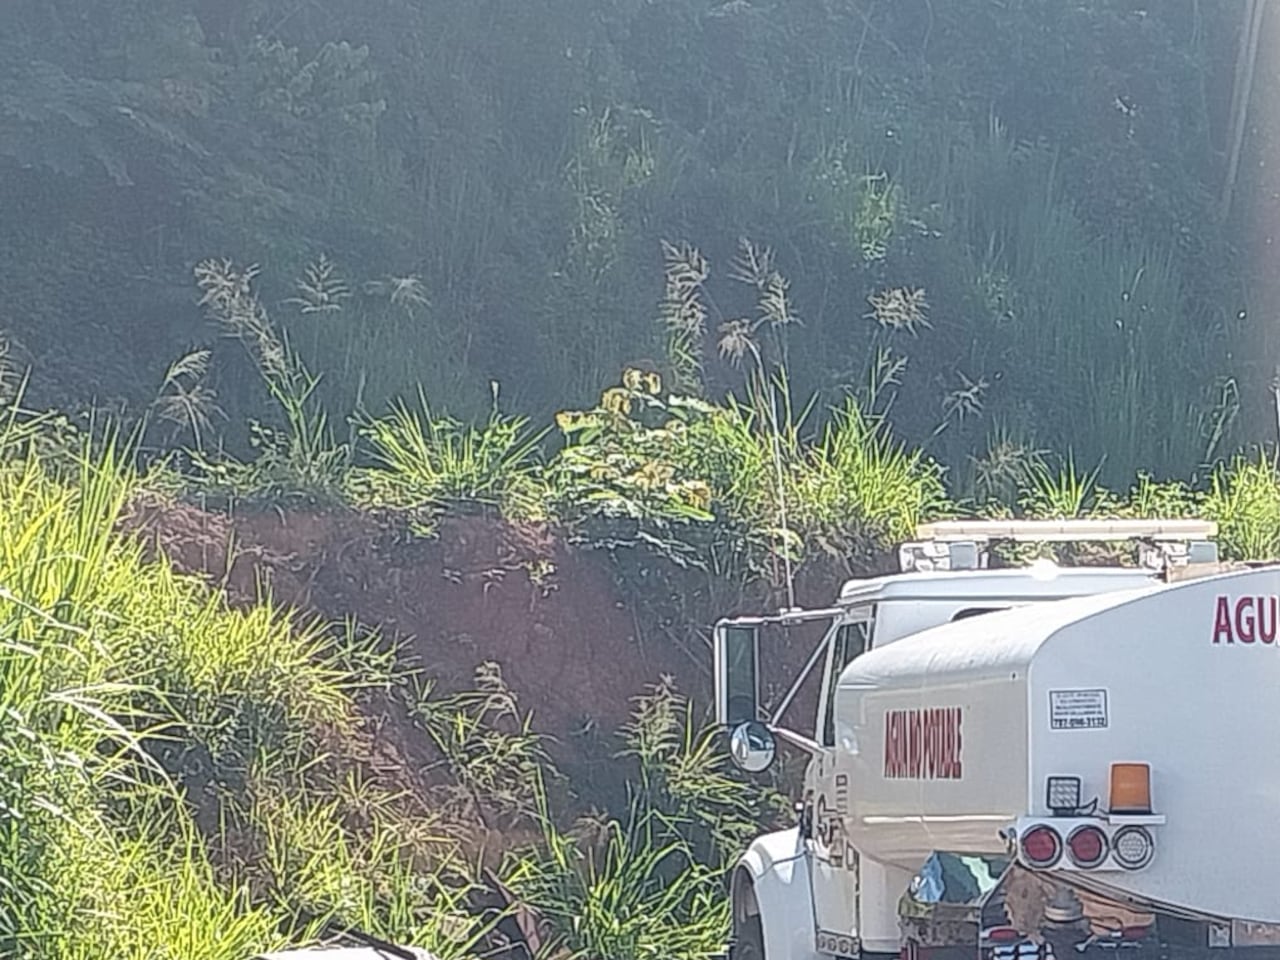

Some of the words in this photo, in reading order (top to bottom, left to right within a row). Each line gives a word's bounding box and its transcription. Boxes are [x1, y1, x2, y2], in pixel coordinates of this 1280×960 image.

[884, 709, 908, 779] AGUA
[909, 708, 922, 780] NO
[922, 706, 963, 780] POTABLE
